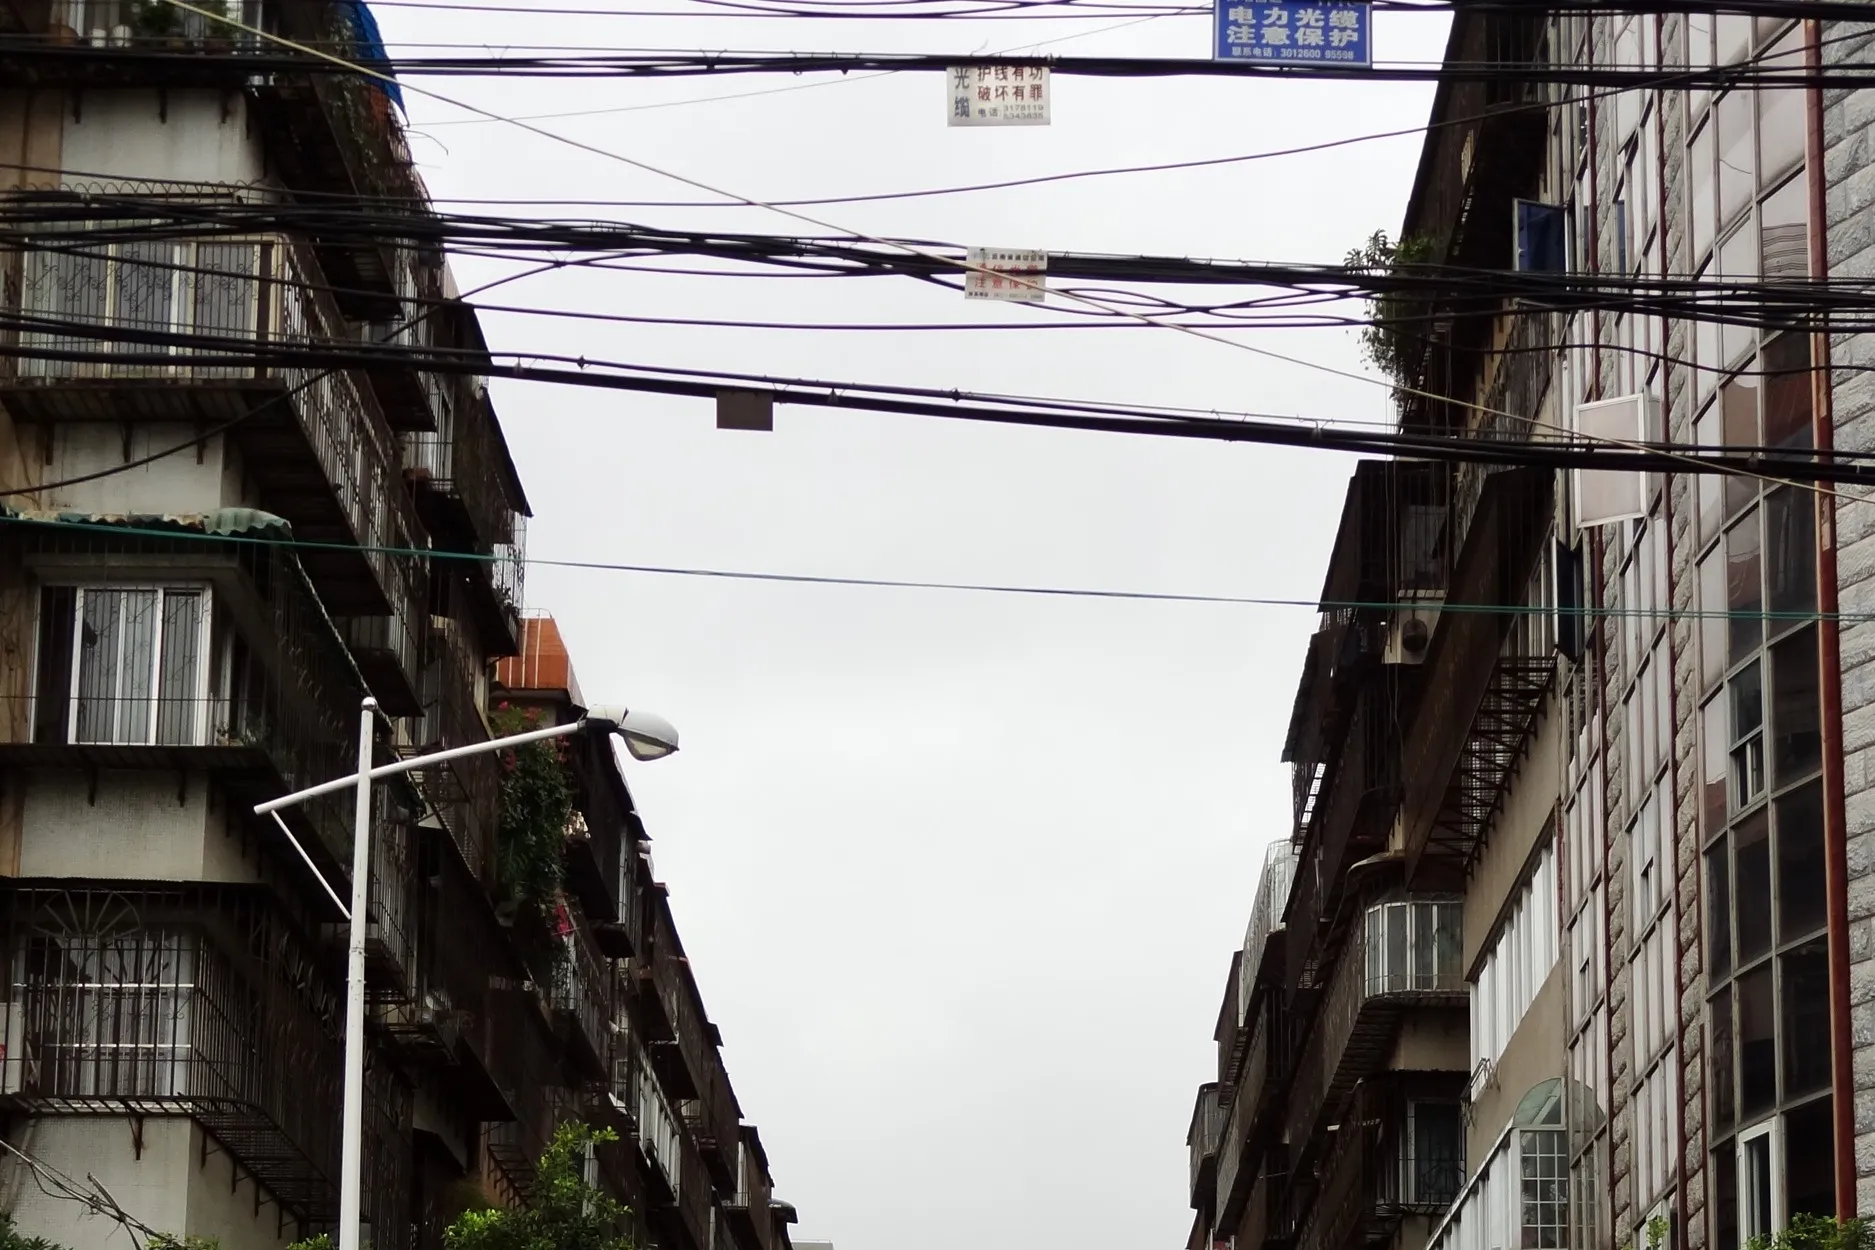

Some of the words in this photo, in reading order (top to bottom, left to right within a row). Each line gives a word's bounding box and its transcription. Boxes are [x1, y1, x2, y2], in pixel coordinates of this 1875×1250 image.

[1228, 6, 1360, 28] 电力光缆
[1226, 25, 1359, 47] 注意保护
[977, 66, 1043, 81] 护线有功
[977, 84, 1043, 101] 破坏有罪
